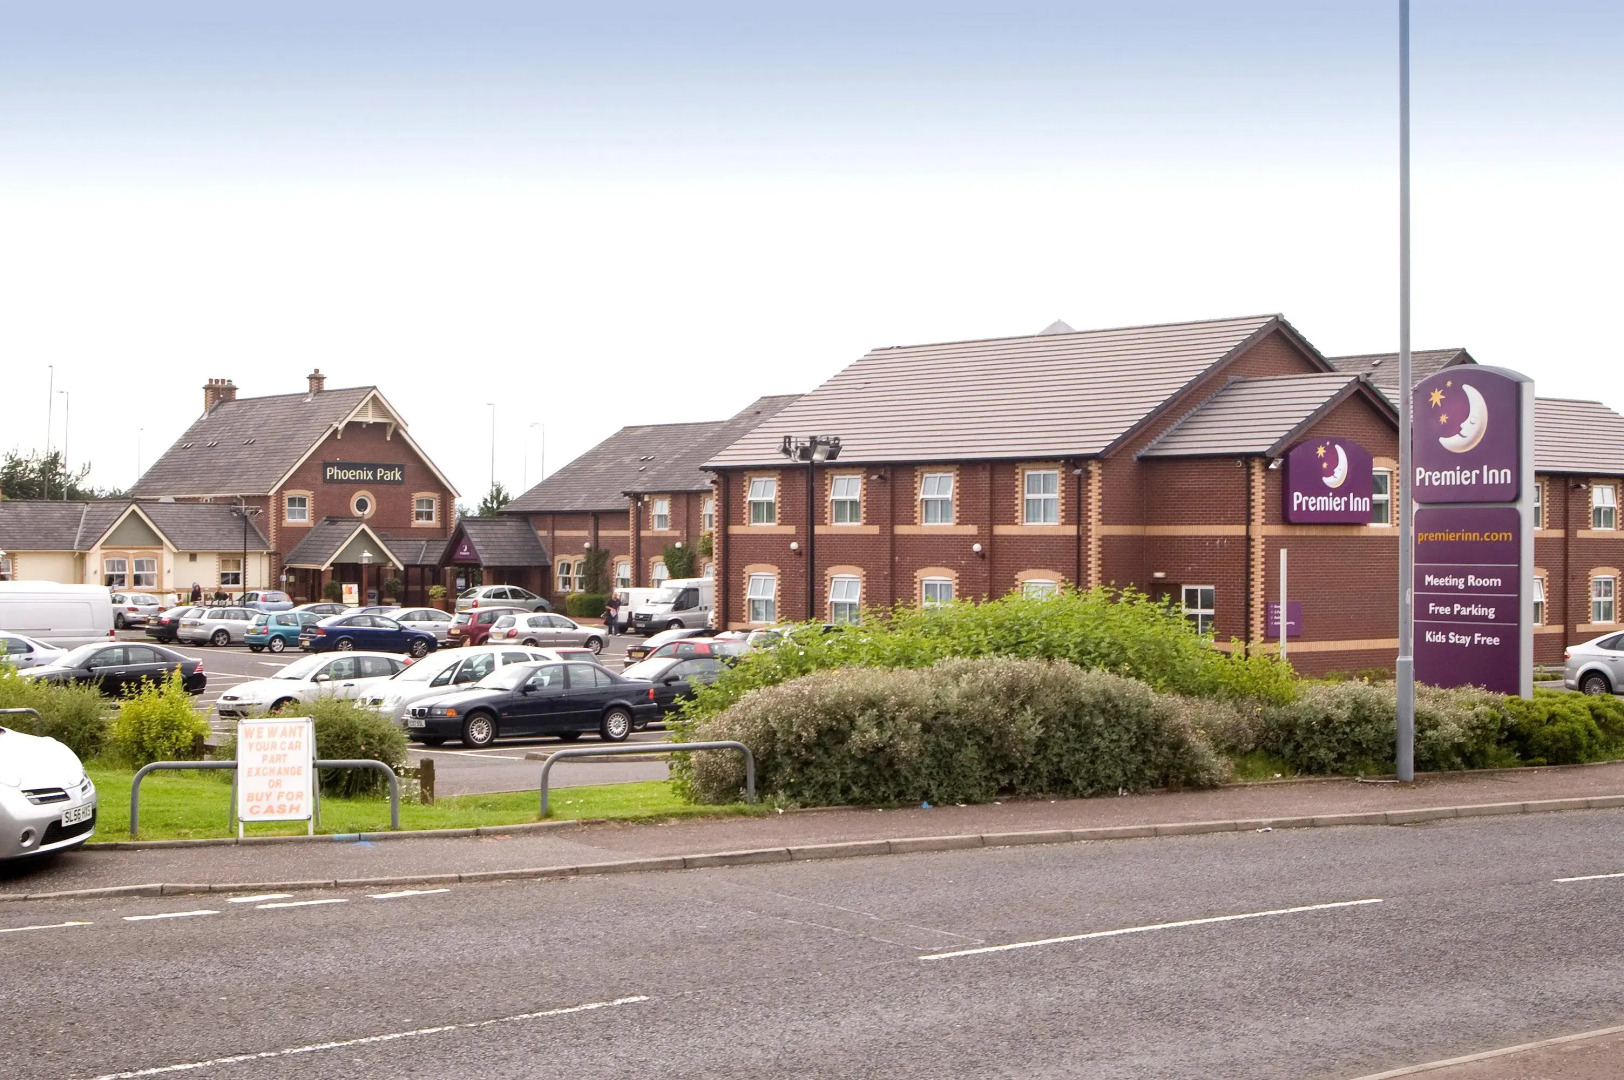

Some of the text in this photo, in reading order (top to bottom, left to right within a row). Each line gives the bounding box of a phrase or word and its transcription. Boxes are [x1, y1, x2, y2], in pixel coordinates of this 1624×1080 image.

[326, 466, 402, 481] Phoenix Park
[1415, 464, 1511, 487] Premier Inn
[1293, 491, 1370, 512] Premier Inn
[1417, 528, 1513, 544] premierinn.com
[1424, 574, 1502, 590] Meeting Room
[1428, 602, 1496, 620] Free Parking
[1425, 630, 1501, 648] Kids Stay Free
[244, 725, 305, 739] WE WANT
[248, 740, 302, 752] YOUR CAR
[262, 753, 288, 764] PART
[246, 766, 303, 777] EXCHANGE
[268, 779, 282, 789] OR
[246, 791, 304, 803] BUY FOR
[249, 803, 302, 816] CASH
